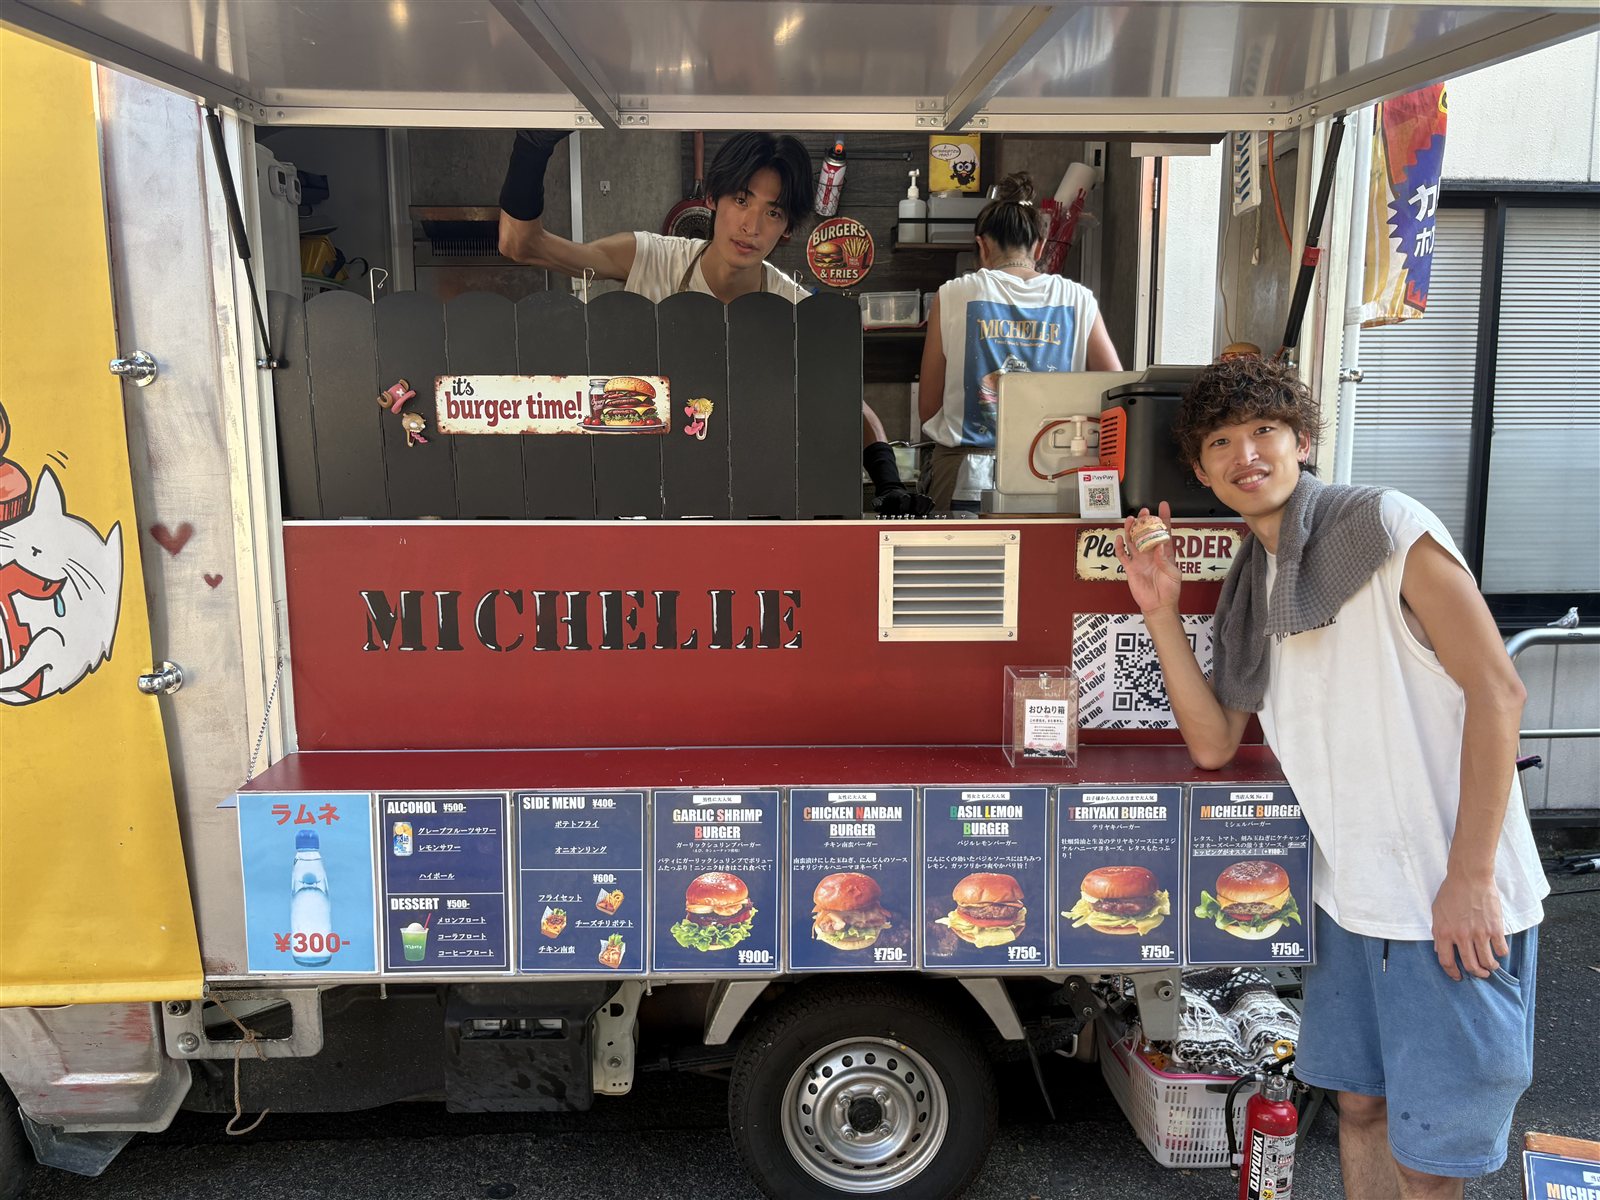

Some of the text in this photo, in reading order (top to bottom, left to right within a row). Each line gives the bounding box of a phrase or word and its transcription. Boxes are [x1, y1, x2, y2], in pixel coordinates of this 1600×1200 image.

[812, 223, 866, 246] BURGERS
[820, 269, 859, 279] & FRIES
[977, 319, 1061, 345] MICHELLE
[452, 378, 474, 397] it's
[445, 391, 583, 427] burger time!
[1083, 535, 1233, 559] Ple RDER
[358, 589, 803, 651] MICHELLE
[1087, 625, 1108, 645] follo
[1029, 705, 1065, 714] おひねり箱
[387, 801, 437, 814] ALCOHOL
[523, 797, 550, 809] SIDE
[552, 797, 586, 809] MENU
[271, 803, 340, 825] ラムネ
[673, 808, 763, 822] GARLIC SHRIMP
[803, 806, 903, 820] CHICKEN NANBAN
[950, 805, 1023, 818] BASIL LEMON
[1068, 806, 1167, 820] TERIYAKI BURGER
[1200, 804, 1301, 818] MICHELLE BURGER
[555, 820, 600, 828] ポテトフライ
[829, 823, 876, 836] BURGER
[963, 822, 1010, 835] BURGER
[694, 826, 741, 839] BURGER
[555, 846, 607, 854] オニオンリング
[419, 872, 455, 880] ハイボール
[593, 874, 617, 883] ¥600-
[391, 898, 440, 910] DESSERT
[437, 916, 487, 924] メロンフロート
[575, 920, 634, 928] チーズチリポテト
[274, 933, 350, 953] ¥300-
[1272, 942, 1304, 955] ¥750-
[438, 949, 494, 957] コーヒーフロート
[738, 950, 774, 963] ¥900-
[874, 948, 907, 961] ¥750-
[1008, 946, 1041, 959] ¥750-
[1141, 945, 1175, 958] ¥750-
[1250, 1135, 1264, 1193] YAMATO
